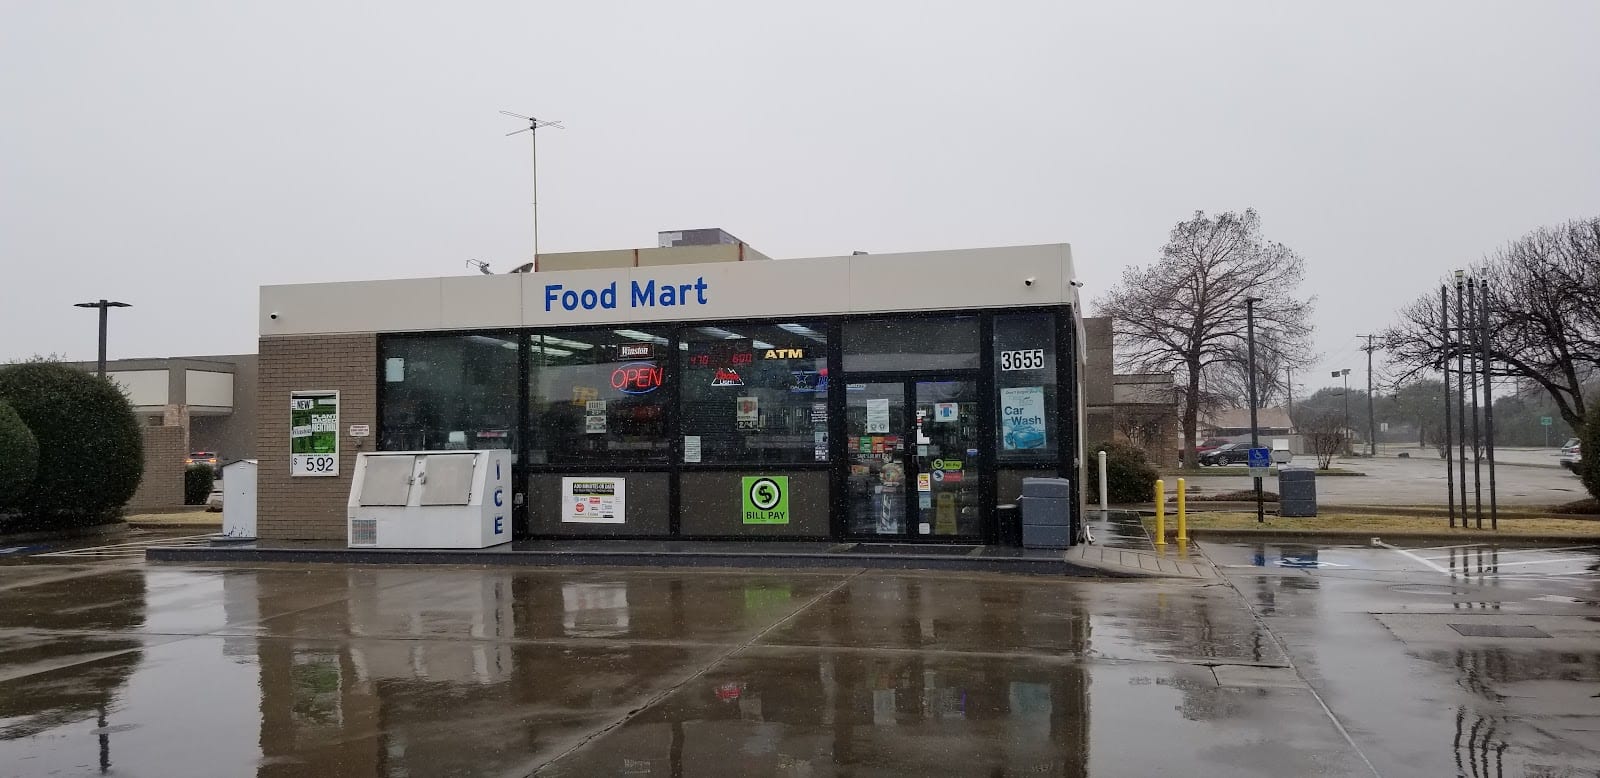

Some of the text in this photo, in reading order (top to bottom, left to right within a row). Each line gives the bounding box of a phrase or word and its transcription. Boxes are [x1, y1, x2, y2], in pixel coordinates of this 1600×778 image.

[545, 277, 708, 312] Food Mart
[622, 346, 649, 357] Winston
[764, 348, 803, 359] ATM
[1002, 351, 1043, 370] 3655
[611, 367, 664, 388] OPEN
[297, 400, 311, 409] NEW
[1004, 406, 1024, 416] Car
[1011, 415, 1042, 426] Wash
[306, 457, 334, 473] 5.92
[746, 512, 785, 520] BILL PAY
